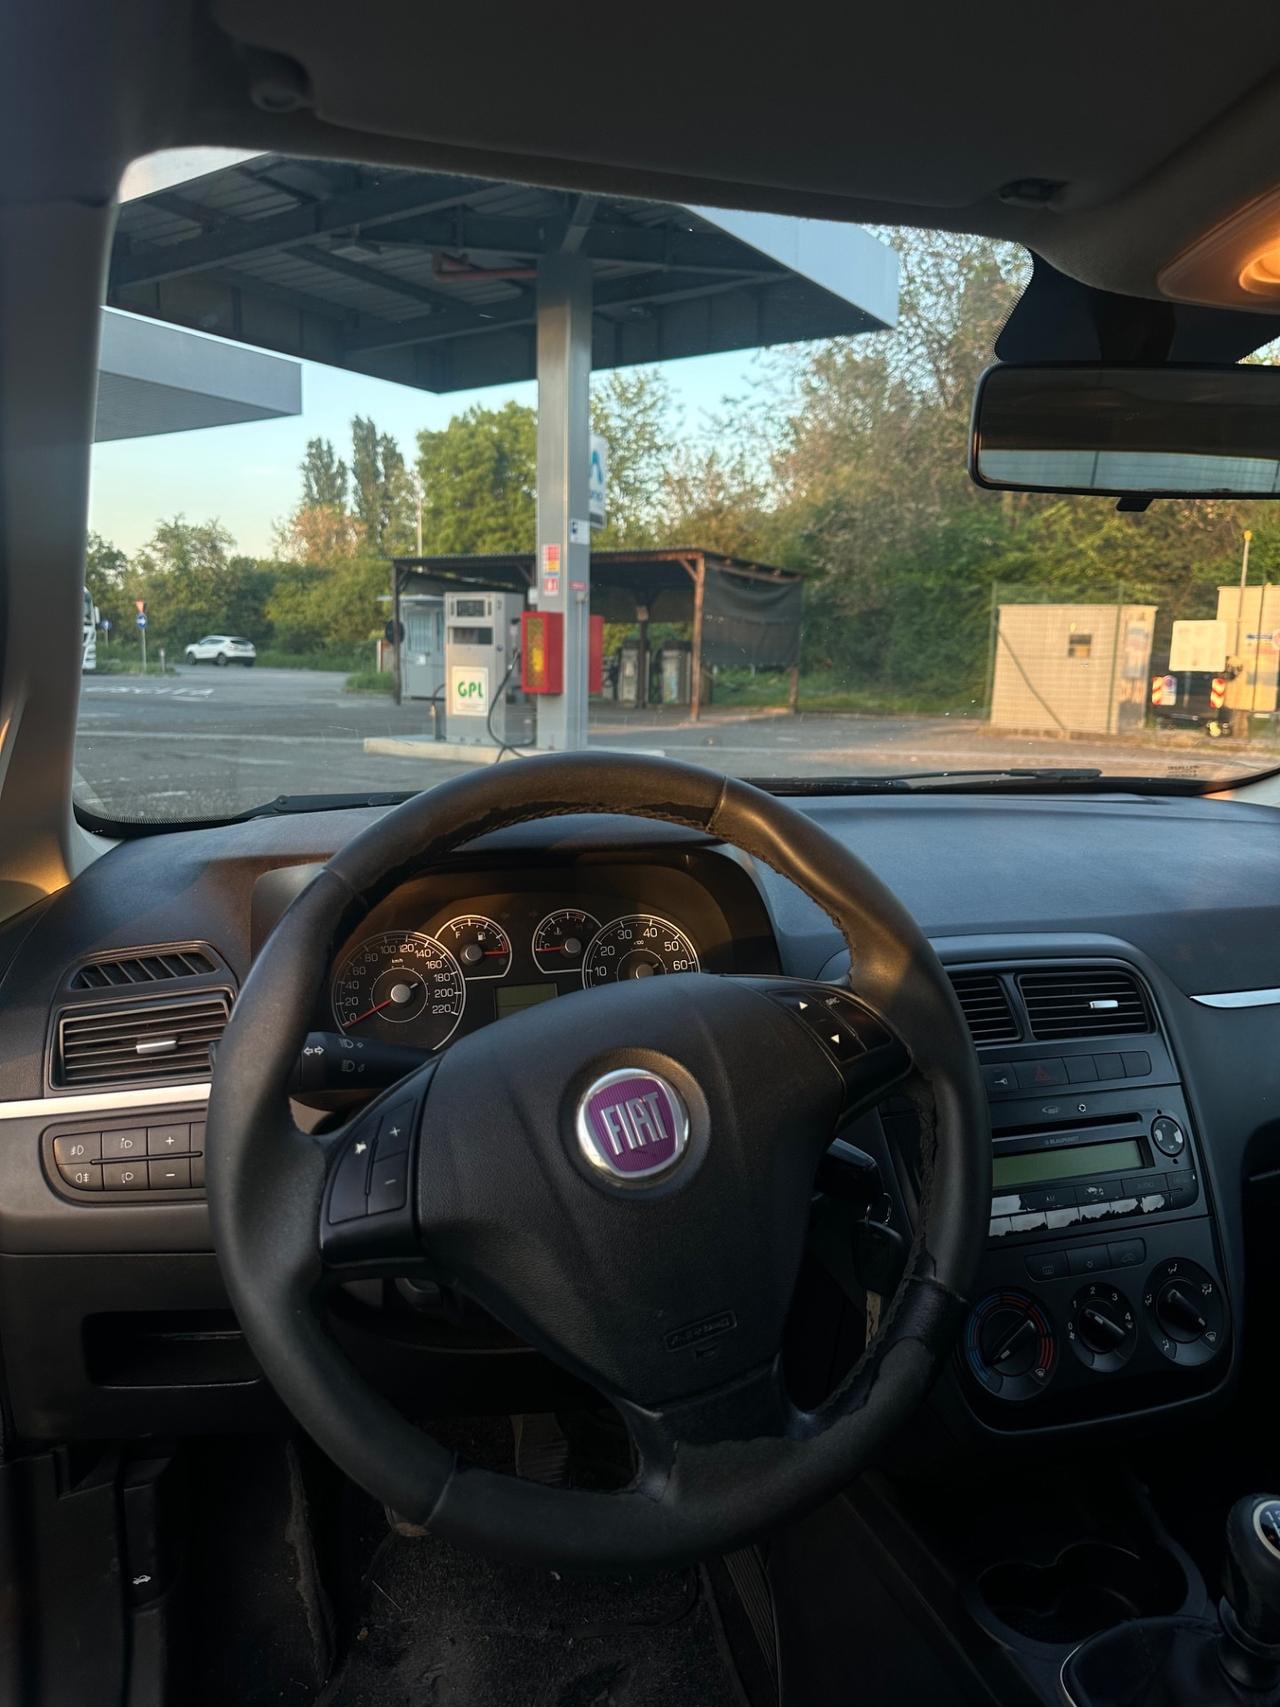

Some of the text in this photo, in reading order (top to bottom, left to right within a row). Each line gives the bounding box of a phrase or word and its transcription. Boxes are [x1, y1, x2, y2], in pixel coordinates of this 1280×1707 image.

[458, 681, 482, 698] GPL
[618, 929, 632, 940] 30
[643, 927, 658, 938] 40
[381, 945, 397, 954] 100
[400, 943, 415, 952] 120
[600, 945, 615, 956] 20
[664, 941, 679, 952] 50
[365, 953, 378, 962] 80
[415, 949, 431, 957] 140
[425, 960, 442, 969] 160
[673, 960, 688, 971] 60
[353, 966, 366, 976] 60
[595, 966, 607, 977] 10
[434, 972, 451, 982] 180
[345, 981, 359, 990] 40
[434, 989, 454, 999] 200
[345, 997, 359, 1006] 20
[432, 1004, 451, 1014] 220
[349, 1013, 357, 1022] 0
[601, 1091, 668, 1156] FIAT
[1090, 1286, 1096, 1295] 2
[1112, 1292, 1118, 1302] 3
[1073, 1300, 1077, 1309] 1
[1125, 1312, 1131, 1321] 4
[1067, 1321, 1073, 1330] 0
